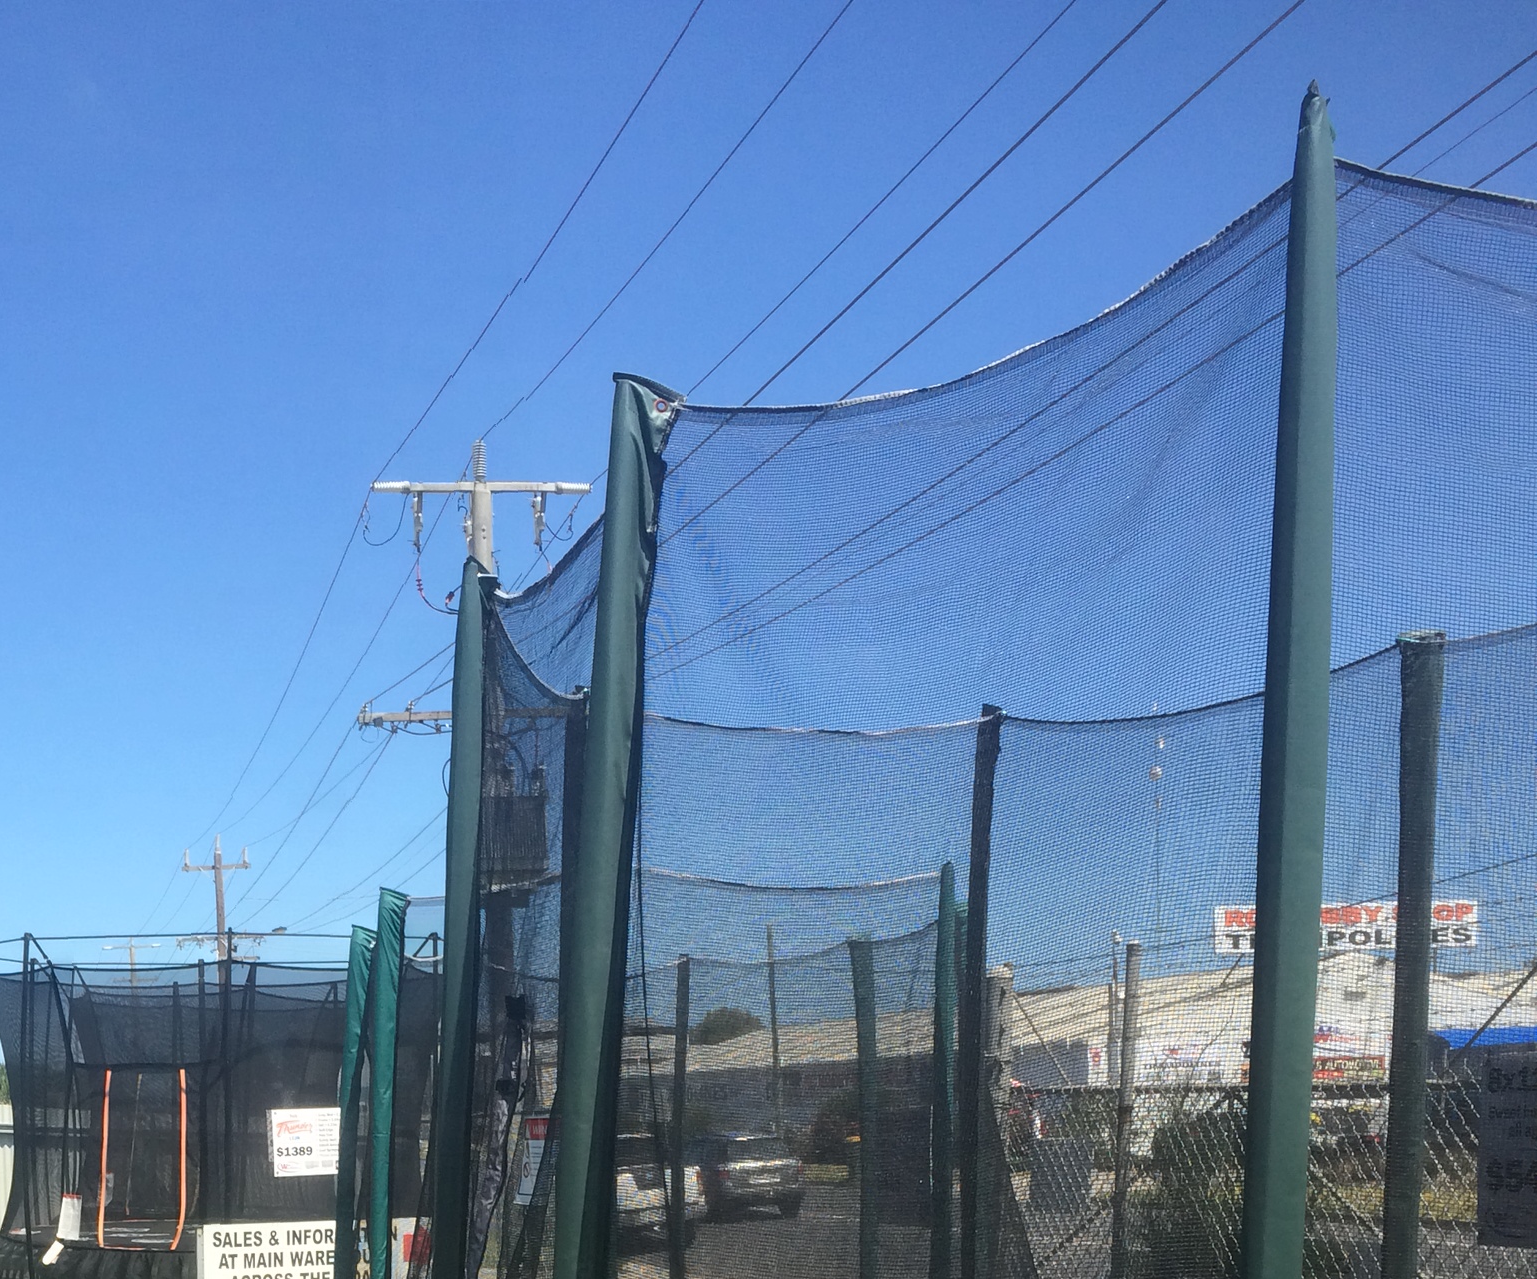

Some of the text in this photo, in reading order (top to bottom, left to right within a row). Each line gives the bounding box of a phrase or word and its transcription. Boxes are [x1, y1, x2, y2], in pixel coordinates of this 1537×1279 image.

[276, 1146, 313, 1158] $1389
[212, 1231, 263, 1248] SALES
[269, 1229, 280, 1246] &
[218, 1253, 239, 1270] AT
[243, 1252, 284, 1269] MAIN
